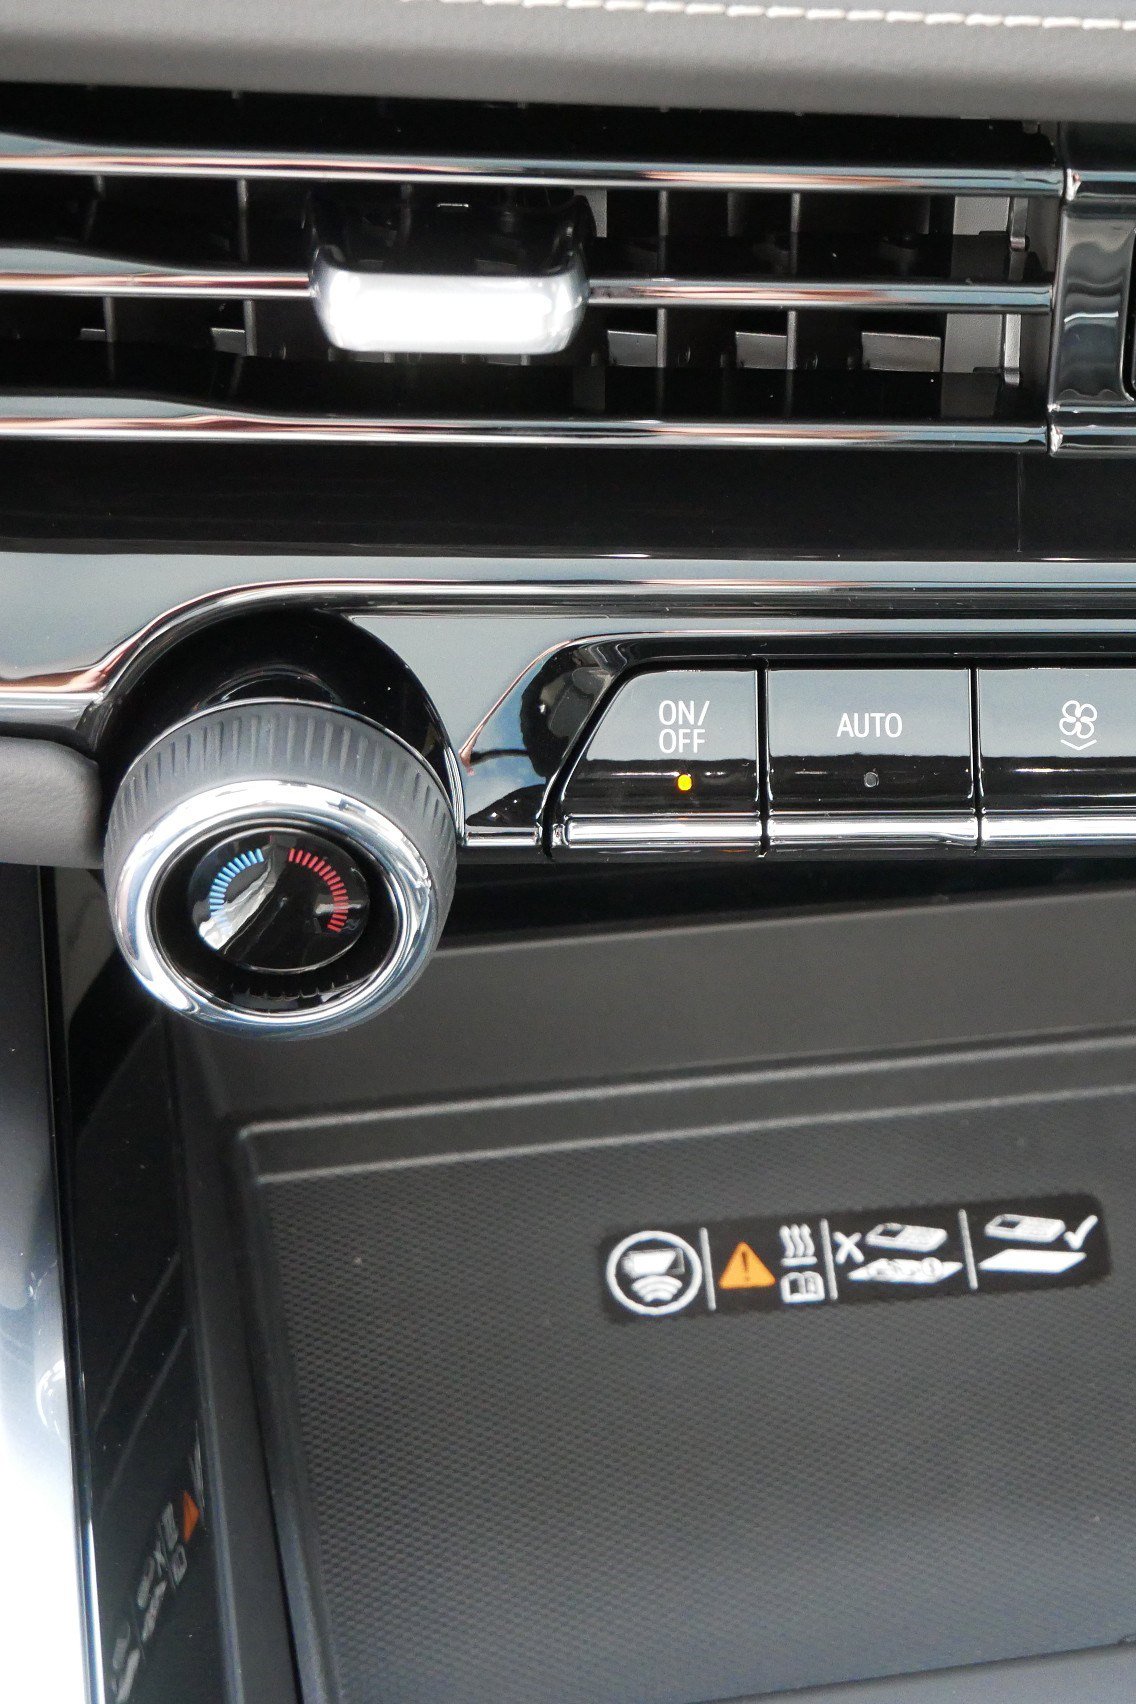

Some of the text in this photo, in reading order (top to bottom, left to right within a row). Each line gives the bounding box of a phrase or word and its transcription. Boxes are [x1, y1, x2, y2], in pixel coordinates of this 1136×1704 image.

[658, 700, 710, 726] ON/
[836, 712, 903, 738] AUTO
[658, 728, 706, 754] OFF
